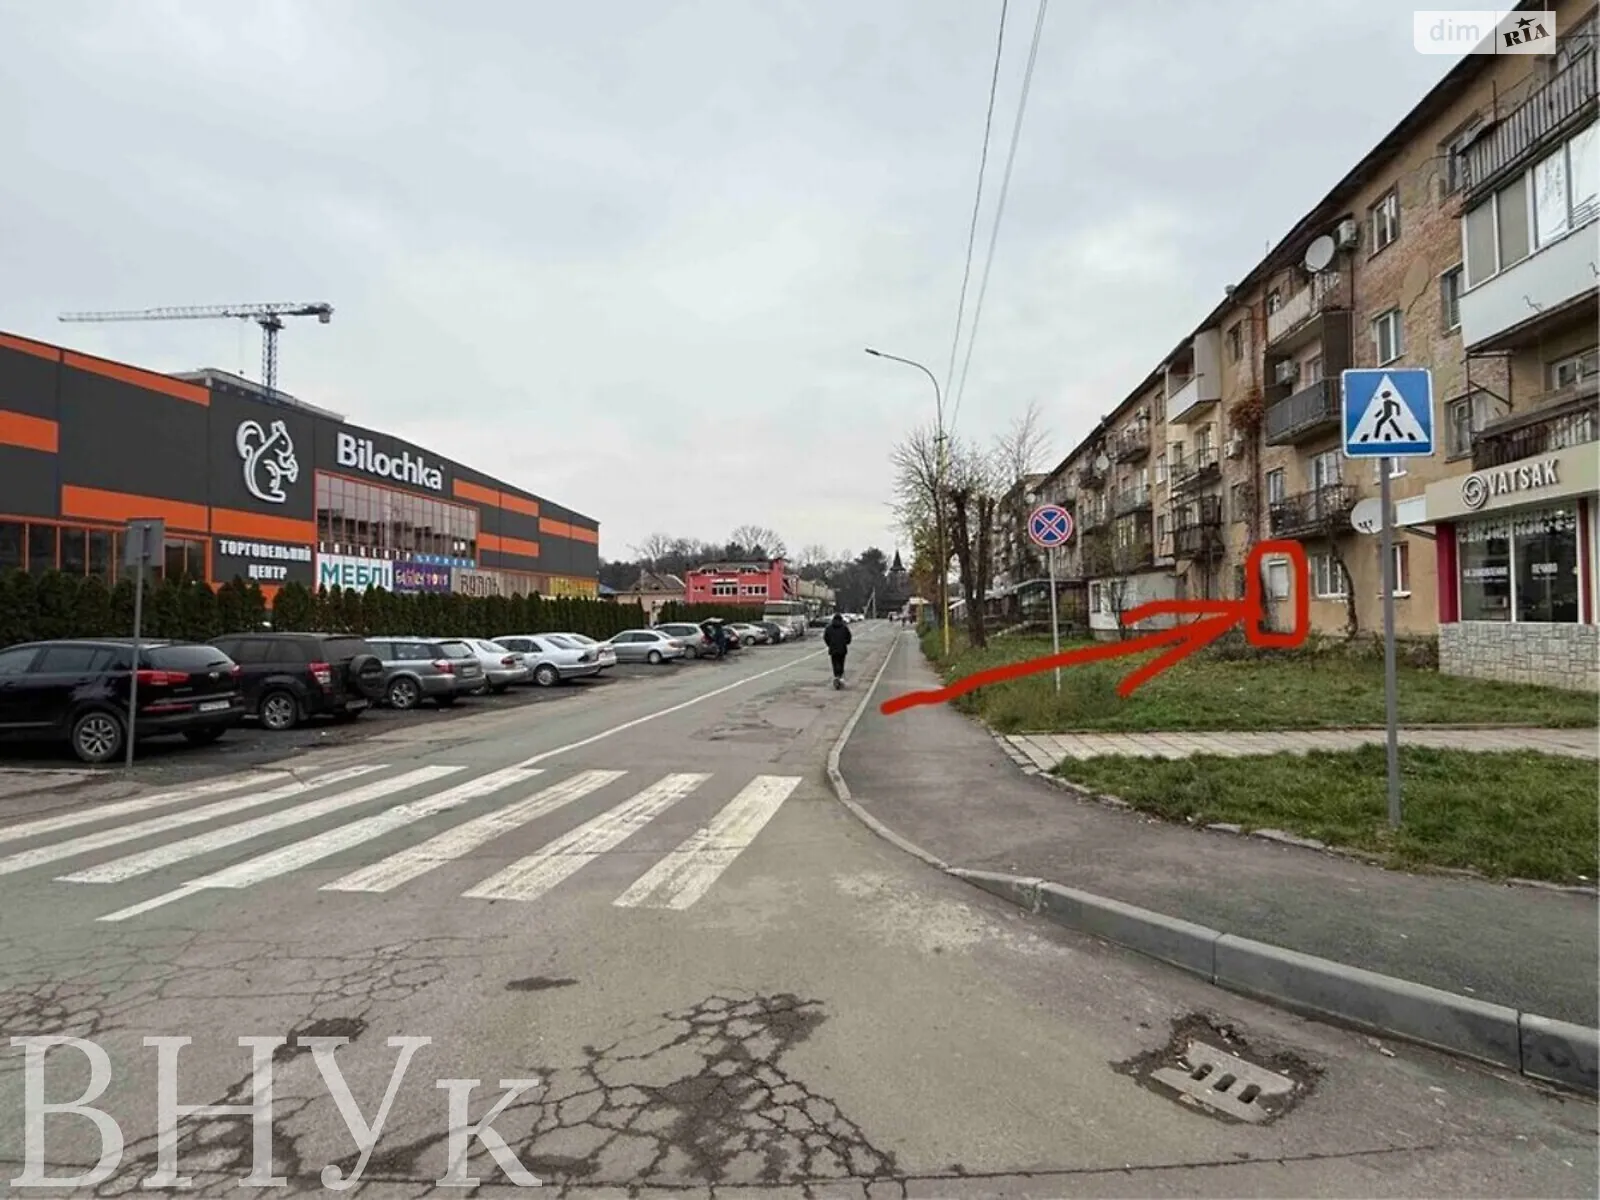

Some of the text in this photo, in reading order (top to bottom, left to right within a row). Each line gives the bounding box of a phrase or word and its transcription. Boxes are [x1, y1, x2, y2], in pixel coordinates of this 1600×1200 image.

[337, 431, 442, 491] Bilochka
[1487, 458, 1559, 496] VATSAK
[248, 564, 288, 579] ЦЕНТР
[320, 562, 389, 587] МЕБЛІ
